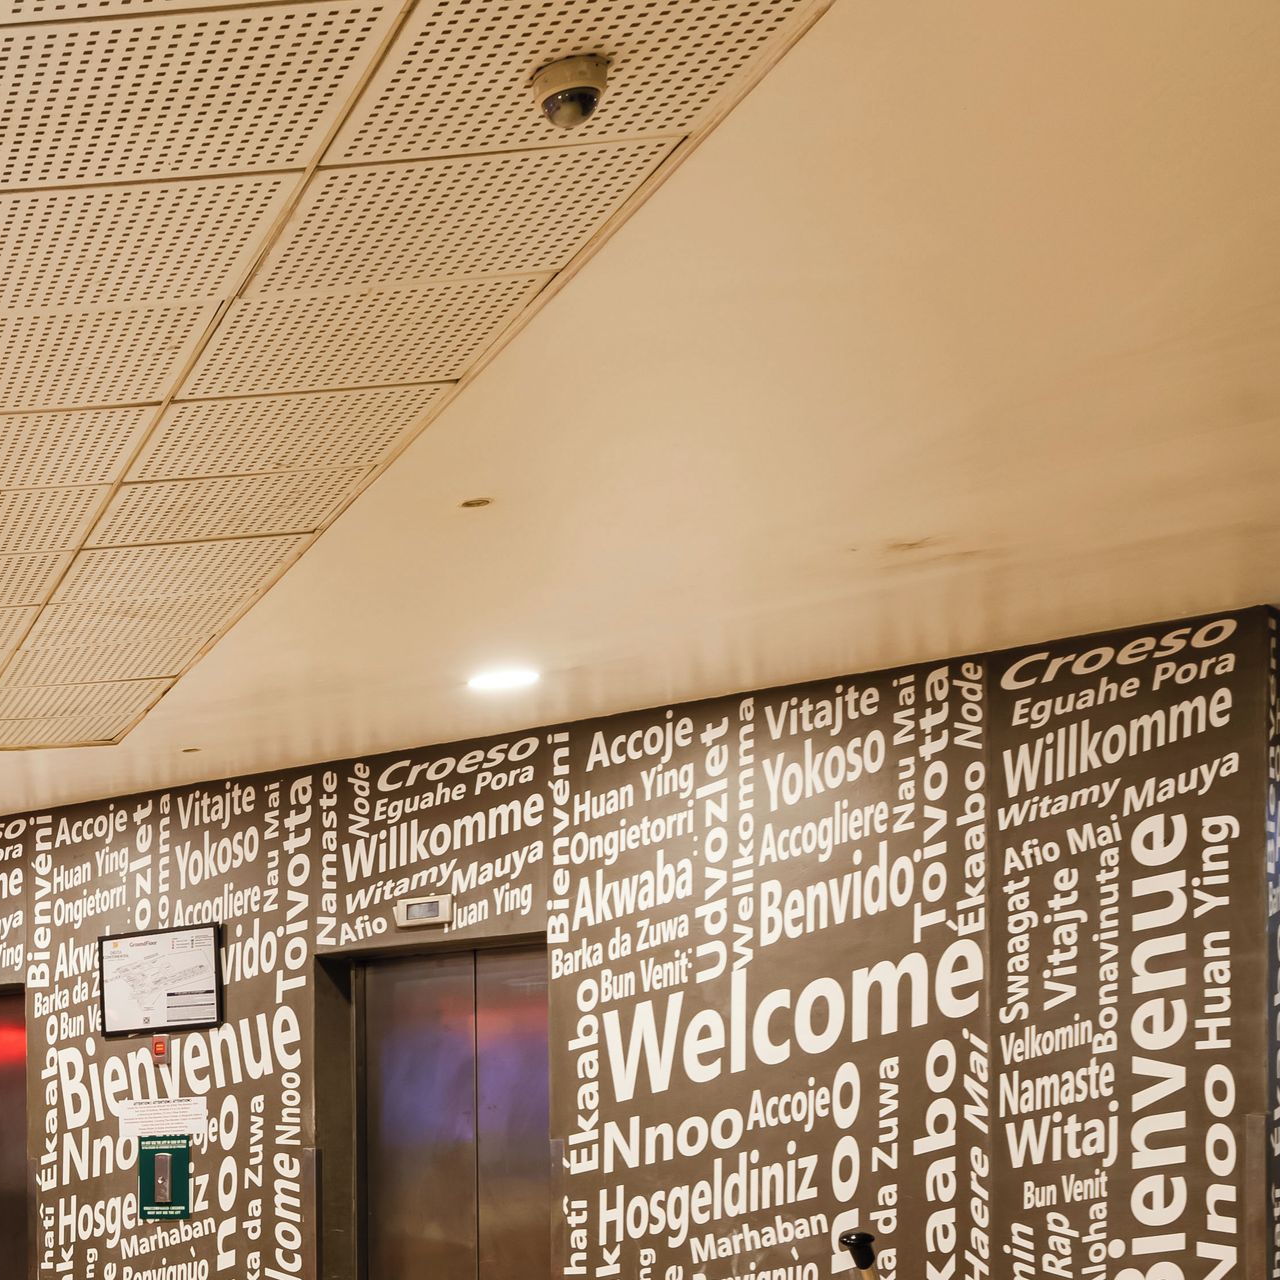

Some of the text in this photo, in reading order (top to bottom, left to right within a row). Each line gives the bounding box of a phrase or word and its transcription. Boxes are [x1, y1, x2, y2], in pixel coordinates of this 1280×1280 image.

[1000, 618, 1237, 691] Croeso
[764, 685, 880, 740] Vitajte
[952, 663, 983, 749] Node
[1011, 653, 1236, 729] Eguahe Pora
[376, 736, 539, 792] Croeso
[585, 710, 694, 772] Accoje
[762, 729, 886, 812] Yokoso
[893, 673, 915, 833] Nau Mai
[1002, 686, 1232, 799] Willkomme
[177, 782, 256, 830] Vitajte
[348, 763, 370, 838] Node
[374, 765, 535, 824] Eguahe Pora
[573, 759, 694, 825] Huan Ying
[913, 666, 949, 943] Toivotta
[997, 777, 1122, 832] Witamy
[1122, 751, 1239, 817] Mauya
[54, 804, 127, 848] Accoje
[175, 826, 259, 890] Yokoso
[263, 781, 280, 912] Nau Mai
[317, 771, 337, 946] Namaste
[342, 793, 544, 883] Willkomme
[547, 732, 570, 944] Bienvéni
[570, 800, 694, 866] Ongietorri
[759, 799, 889, 866] Accogliere
[946, 760, 986, 936] Ékaabo
[1003, 814, 1122, 875] Afio Mai
[27, 815, 52, 988] Bienvéni
[53, 845, 129, 895] Huan Ying
[275, 775, 312, 1004] Toivotta
[345, 859, 457, 915] Witamy
[451, 840, 544, 897] Mauya
[493, 881, 533, 916] Ying
[572, 849, 693, 931] Akwaba
[759, 840, 915, 947] Benvido
[53, 876, 126, 929] Ongietorri
[173, 883, 260, 927] Accogliere
[340, 915, 388, 946] Afio
[1194, 814, 1240, 1049] Huan Ying
[551, 912, 688, 980] Barka da Zuwa
[999, 875, 1039, 1024] Swaagat
[1043, 866, 1088, 1011] Vitajte
[1092, 847, 1120, 1055] Bonavinuta
[34, 984, 69, 1019] Barka
[72, 976, 88, 1004] da
[601, 947, 688, 1003] Bun Venit
[60, 1011, 85, 1041] Bun
[602, 938, 984, 1103] Welcome
[1000, 1013, 1094, 1066] Velkomin
[57, 1005, 301, 1129] Bienvenue
[563, 978, 599, 1175] Ékaabo
[963, 1028, 989, 1134] Mai
[999, 1056, 1116, 1118] Namaste
[276, 1071, 301, 1146] Nnoo
[747, 1077, 830, 1131] Accoje
[1005, 1101, 1119, 1169] Witaj
[245, 1094, 264, 1189] Zuwa
[604, 1108, 741, 1174] Nnoo
[870, 1057, 900, 1235] da Zuwa
[243, 1199, 262, 1240] da
[598, 1141, 818, 1249] Hosgeldiniz
[1023, 1168, 1108, 1210] Bun Venit
[121, 1217, 216, 1260] Marhaban
[690, 1213, 828, 1264] Marhaban
[1042, 1212, 1080, 1279] Rap
